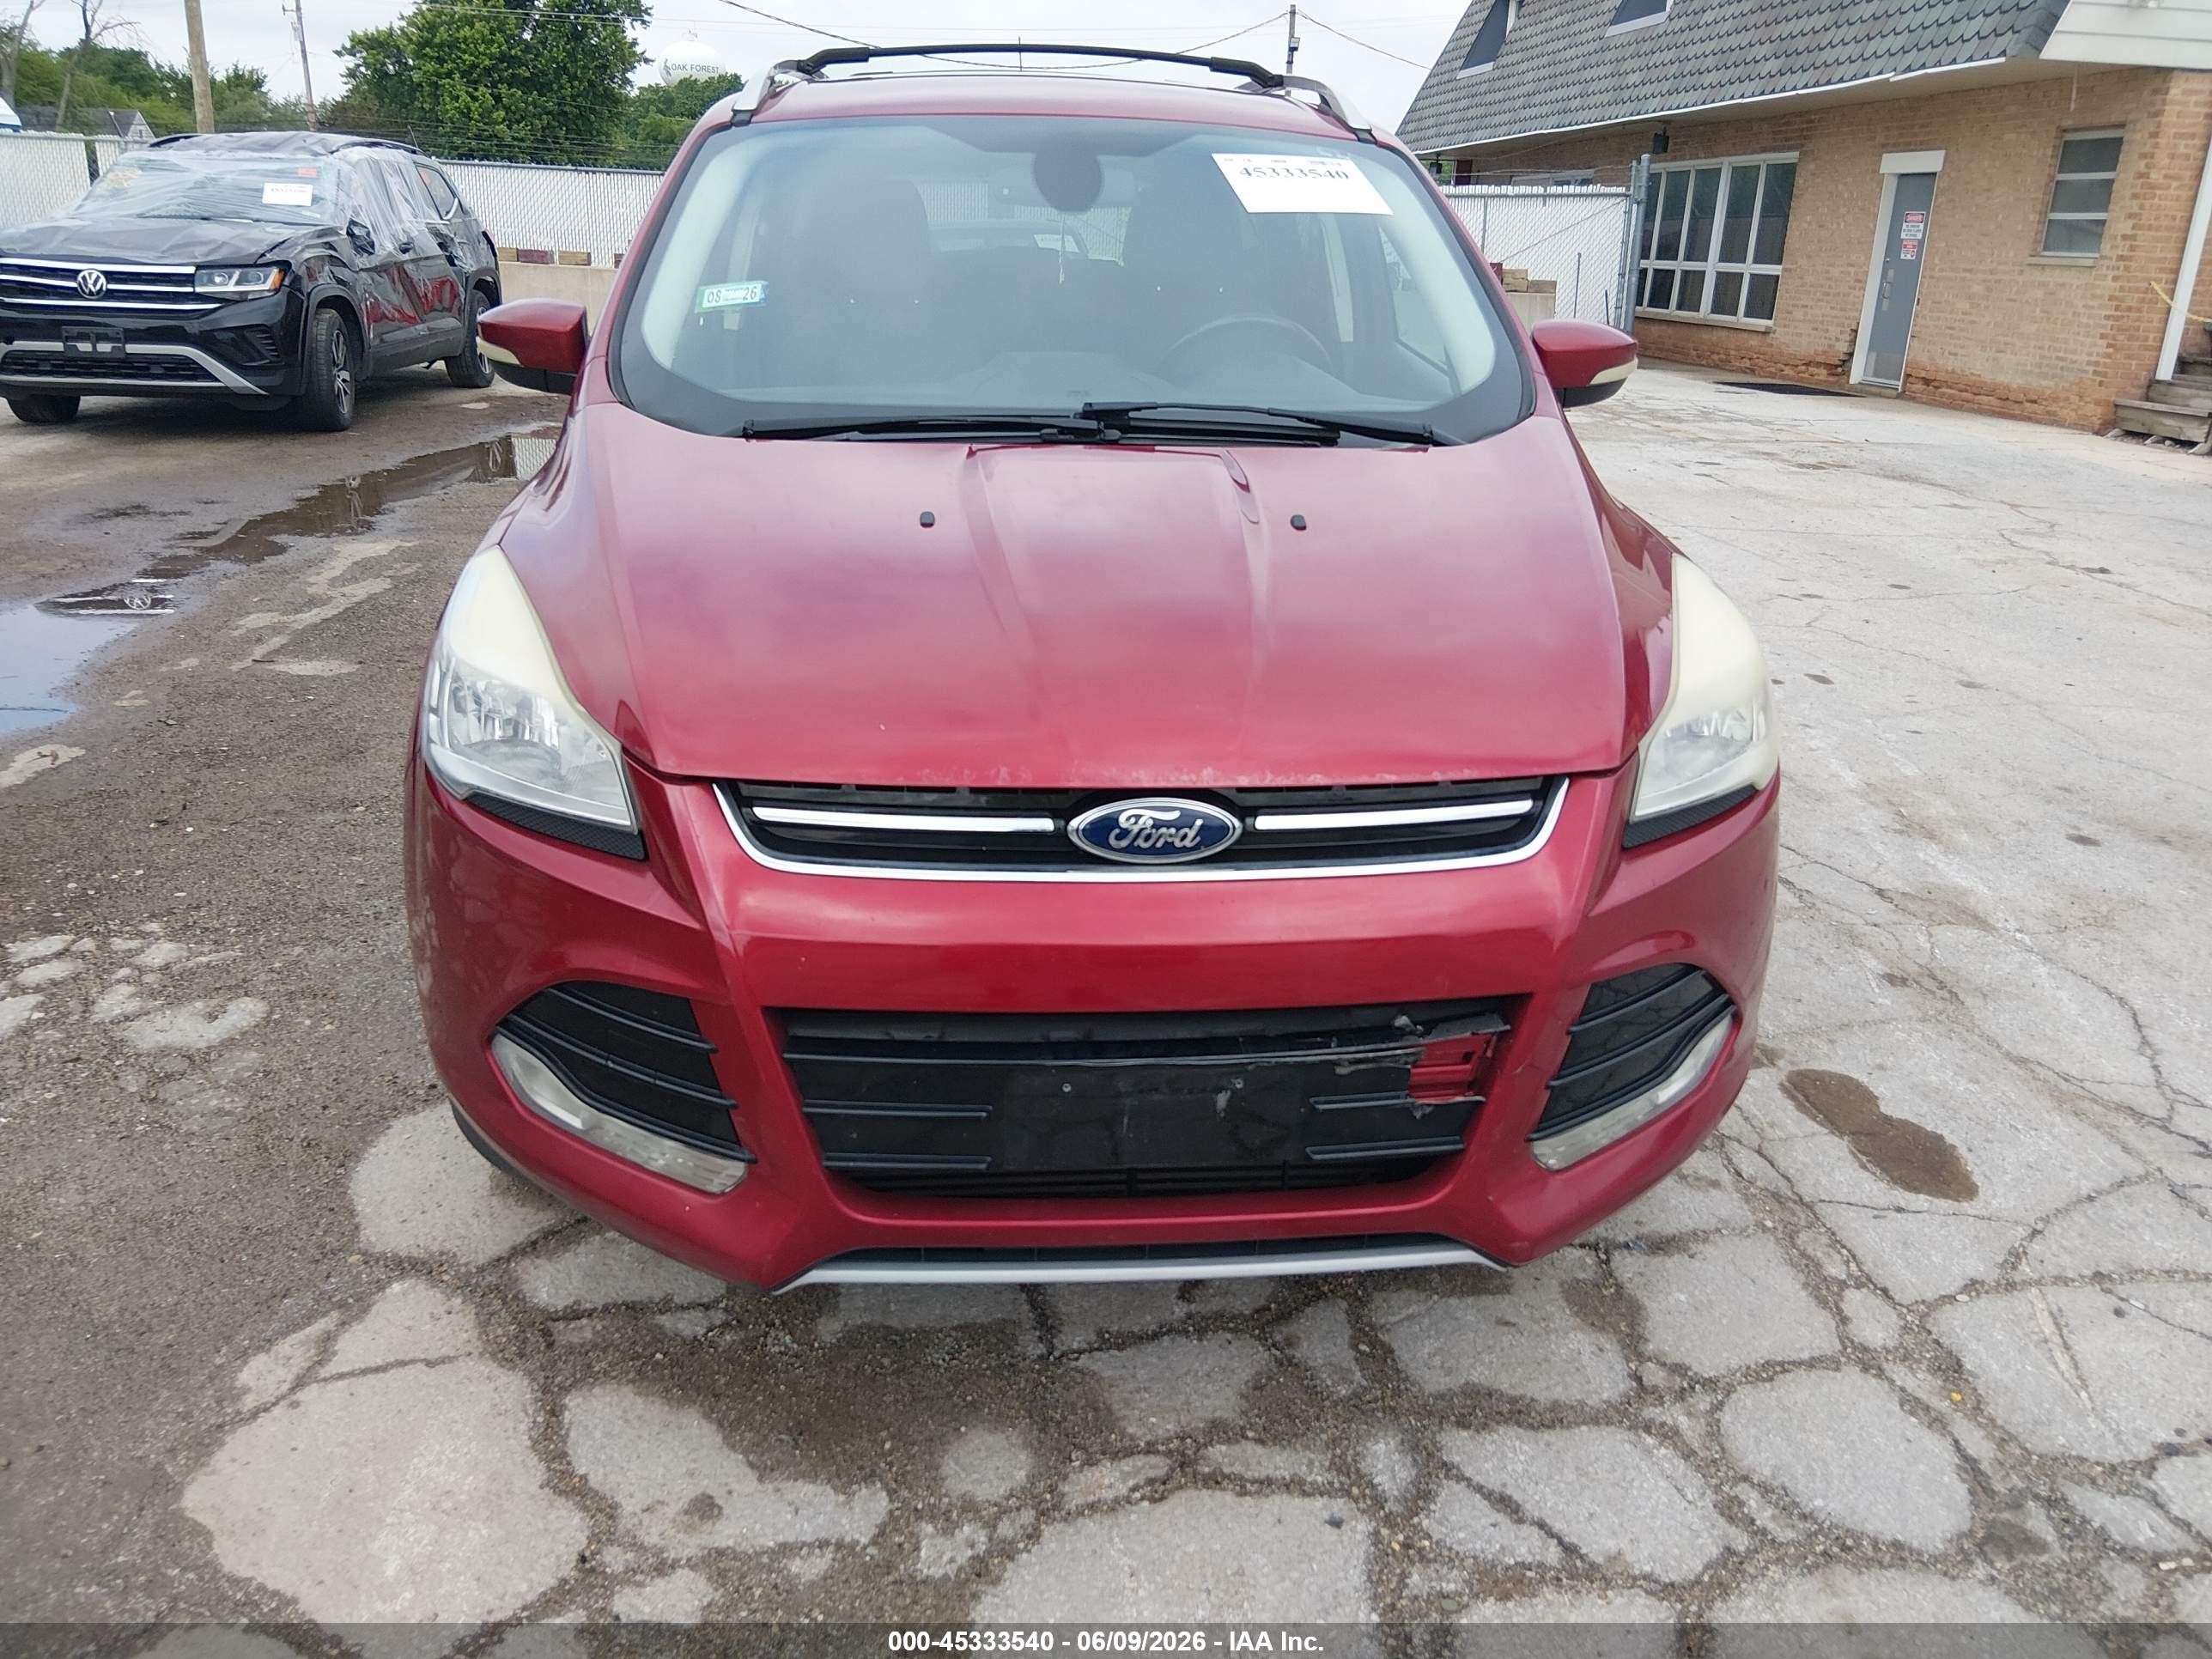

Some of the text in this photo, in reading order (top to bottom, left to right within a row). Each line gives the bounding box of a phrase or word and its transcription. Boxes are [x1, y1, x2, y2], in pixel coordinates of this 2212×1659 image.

[671, 63, 720, 74] OAK FOREST
[1239, 167, 1350, 180] 45333540
[1109, 808, 1204, 849] Ford
